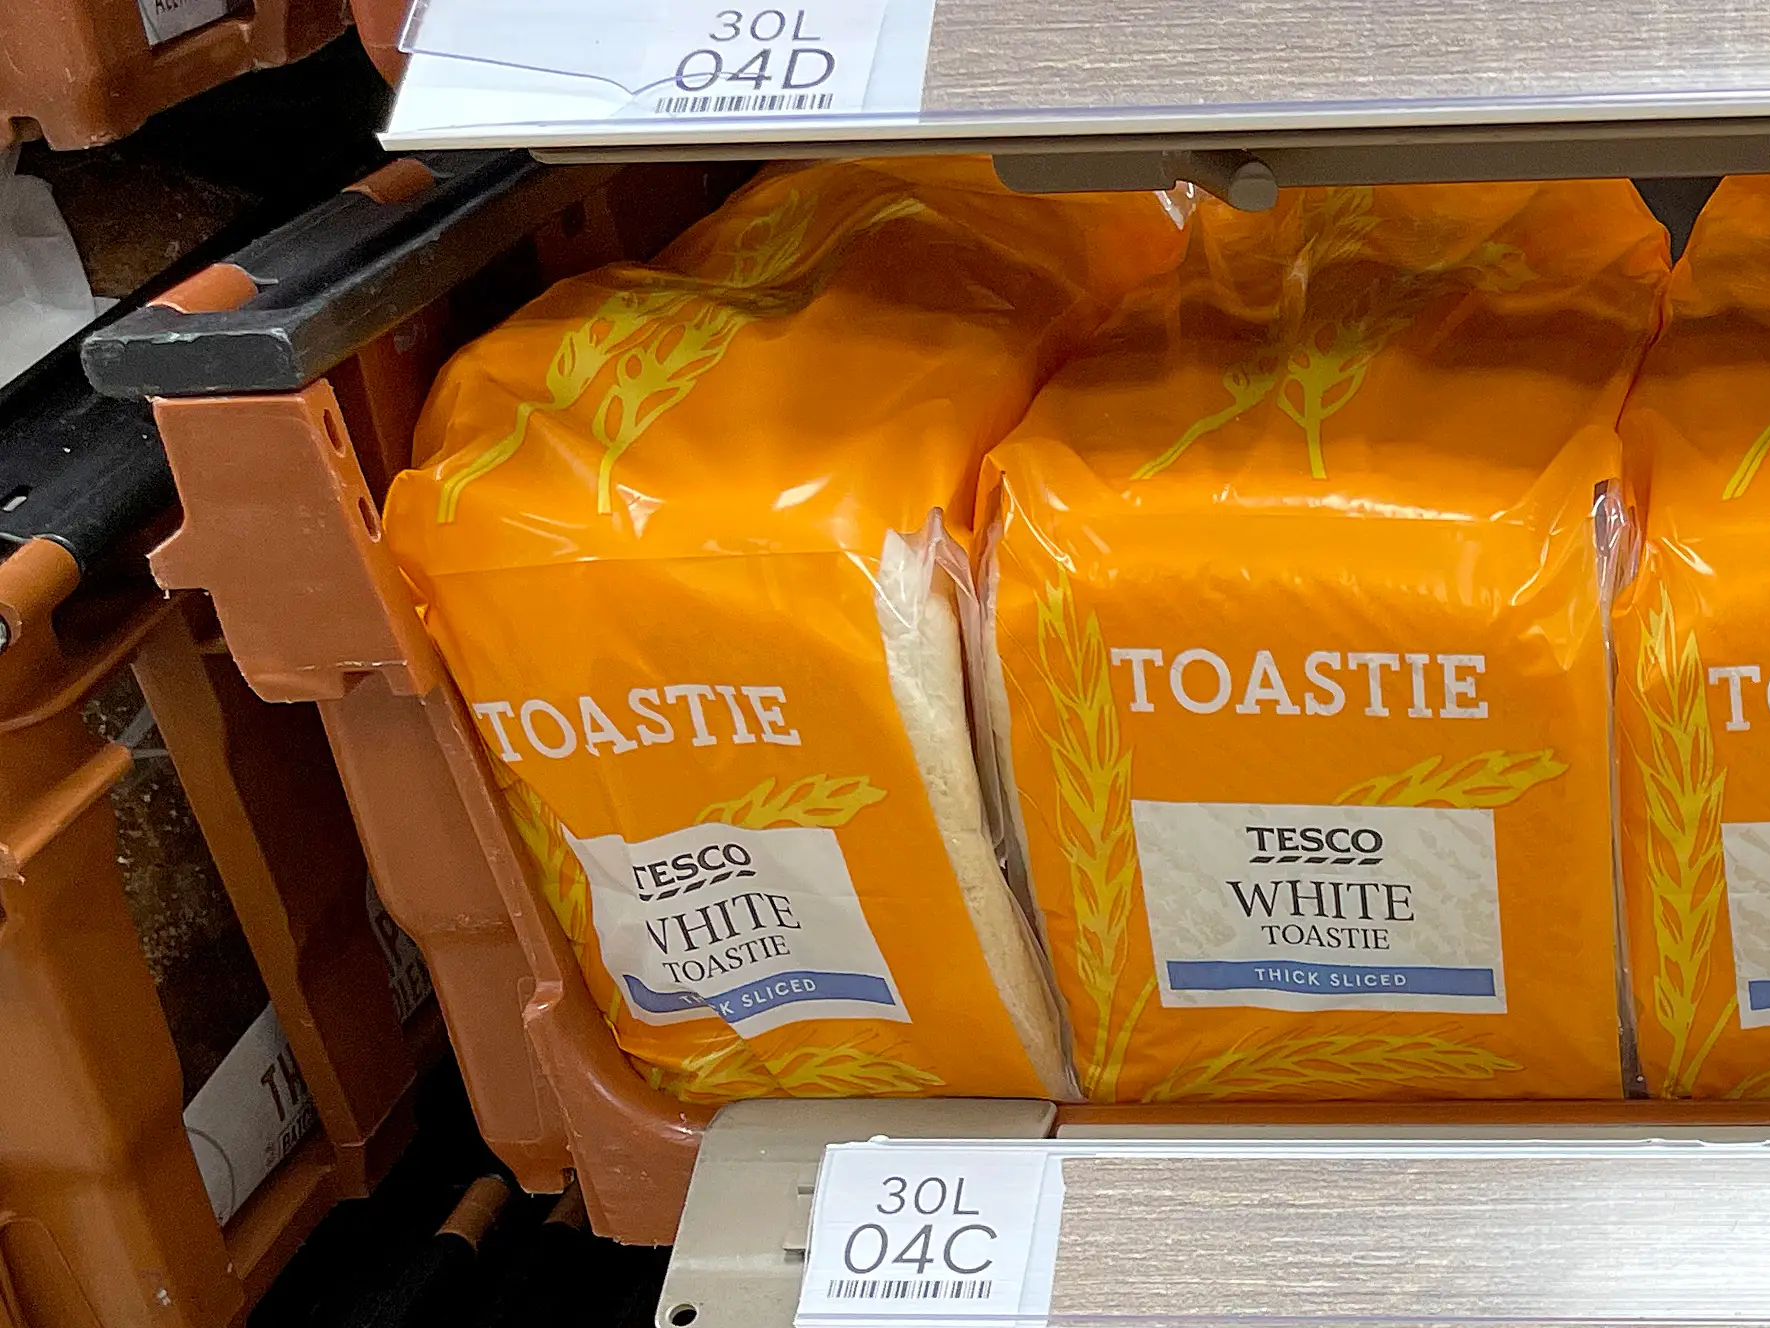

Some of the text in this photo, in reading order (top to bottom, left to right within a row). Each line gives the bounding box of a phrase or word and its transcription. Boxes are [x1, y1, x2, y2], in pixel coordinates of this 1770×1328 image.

[708, 9, 822, 41] 30L
[675, 48, 836, 92] 04D
[1110, 647, 1490, 719] TOASTIE
[473, 684, 802, 763] TOASTIE
[1246, 825, 1384, 854] TESCO
[633, 843, 752, 890] TESCO
[1225, 879, 1415, 922] WHITE
[1261, 923, 1391, 951] TOASTIE
[662, 935, 791, 984] TOASTIE
[1254, 966, 1408, 987] THICK SLICED
[678, 978, 816, 1016] THK SLICED
[876, 1176, 980, 1216] 30L
[843, 1222, 998, 1275] 04C
